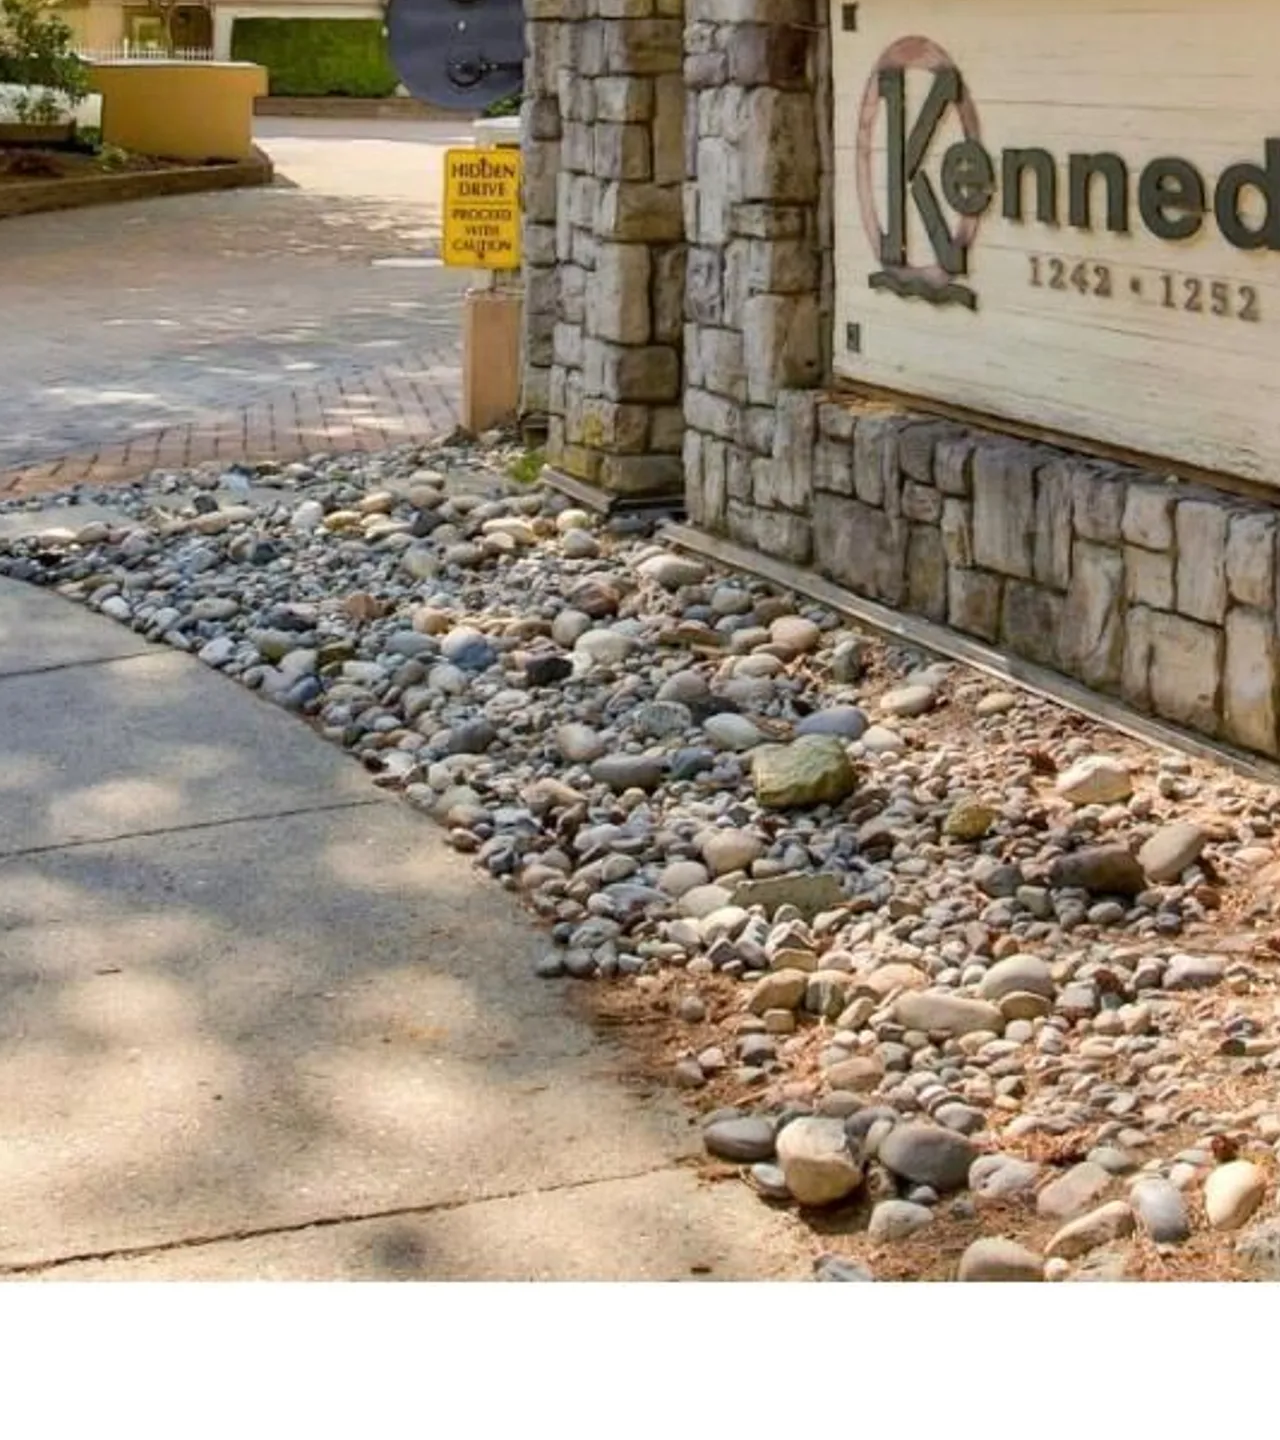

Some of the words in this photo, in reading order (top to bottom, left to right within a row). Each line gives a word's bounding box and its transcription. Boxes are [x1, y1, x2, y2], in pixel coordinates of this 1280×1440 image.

[451, 163, 516, 178] HIDDEN
[459, 181, 505, 196] DRIVE
[452, 208, 512, 220] PROCEED
[451, 239, 512, 251] CAUTION
[1027, 256, 1113, 298] 1242
[1159, 274, 1261, 322] 1252
